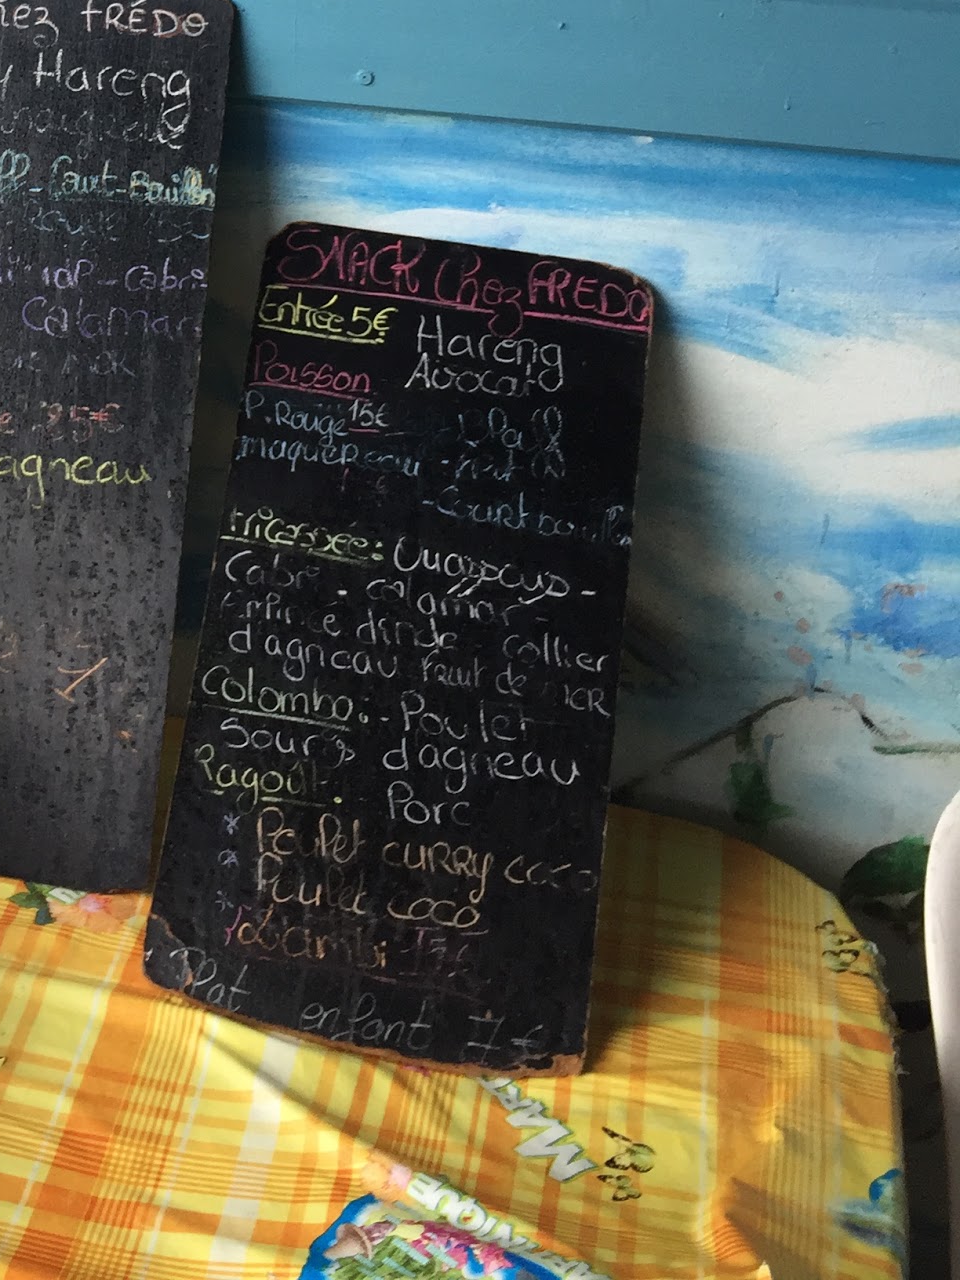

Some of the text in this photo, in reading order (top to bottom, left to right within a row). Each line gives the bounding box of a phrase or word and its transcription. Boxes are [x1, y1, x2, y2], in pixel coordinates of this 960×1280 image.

[278, 228, 426, 294] SNACK
[528, 260, 651, 323] FREDO
[258, 283, 342, 333] Entrée
[254, 340, 371, 394] Poisson
[387, 781, 471, 826] Porc
[300, 992, 431, 1051] enfant
